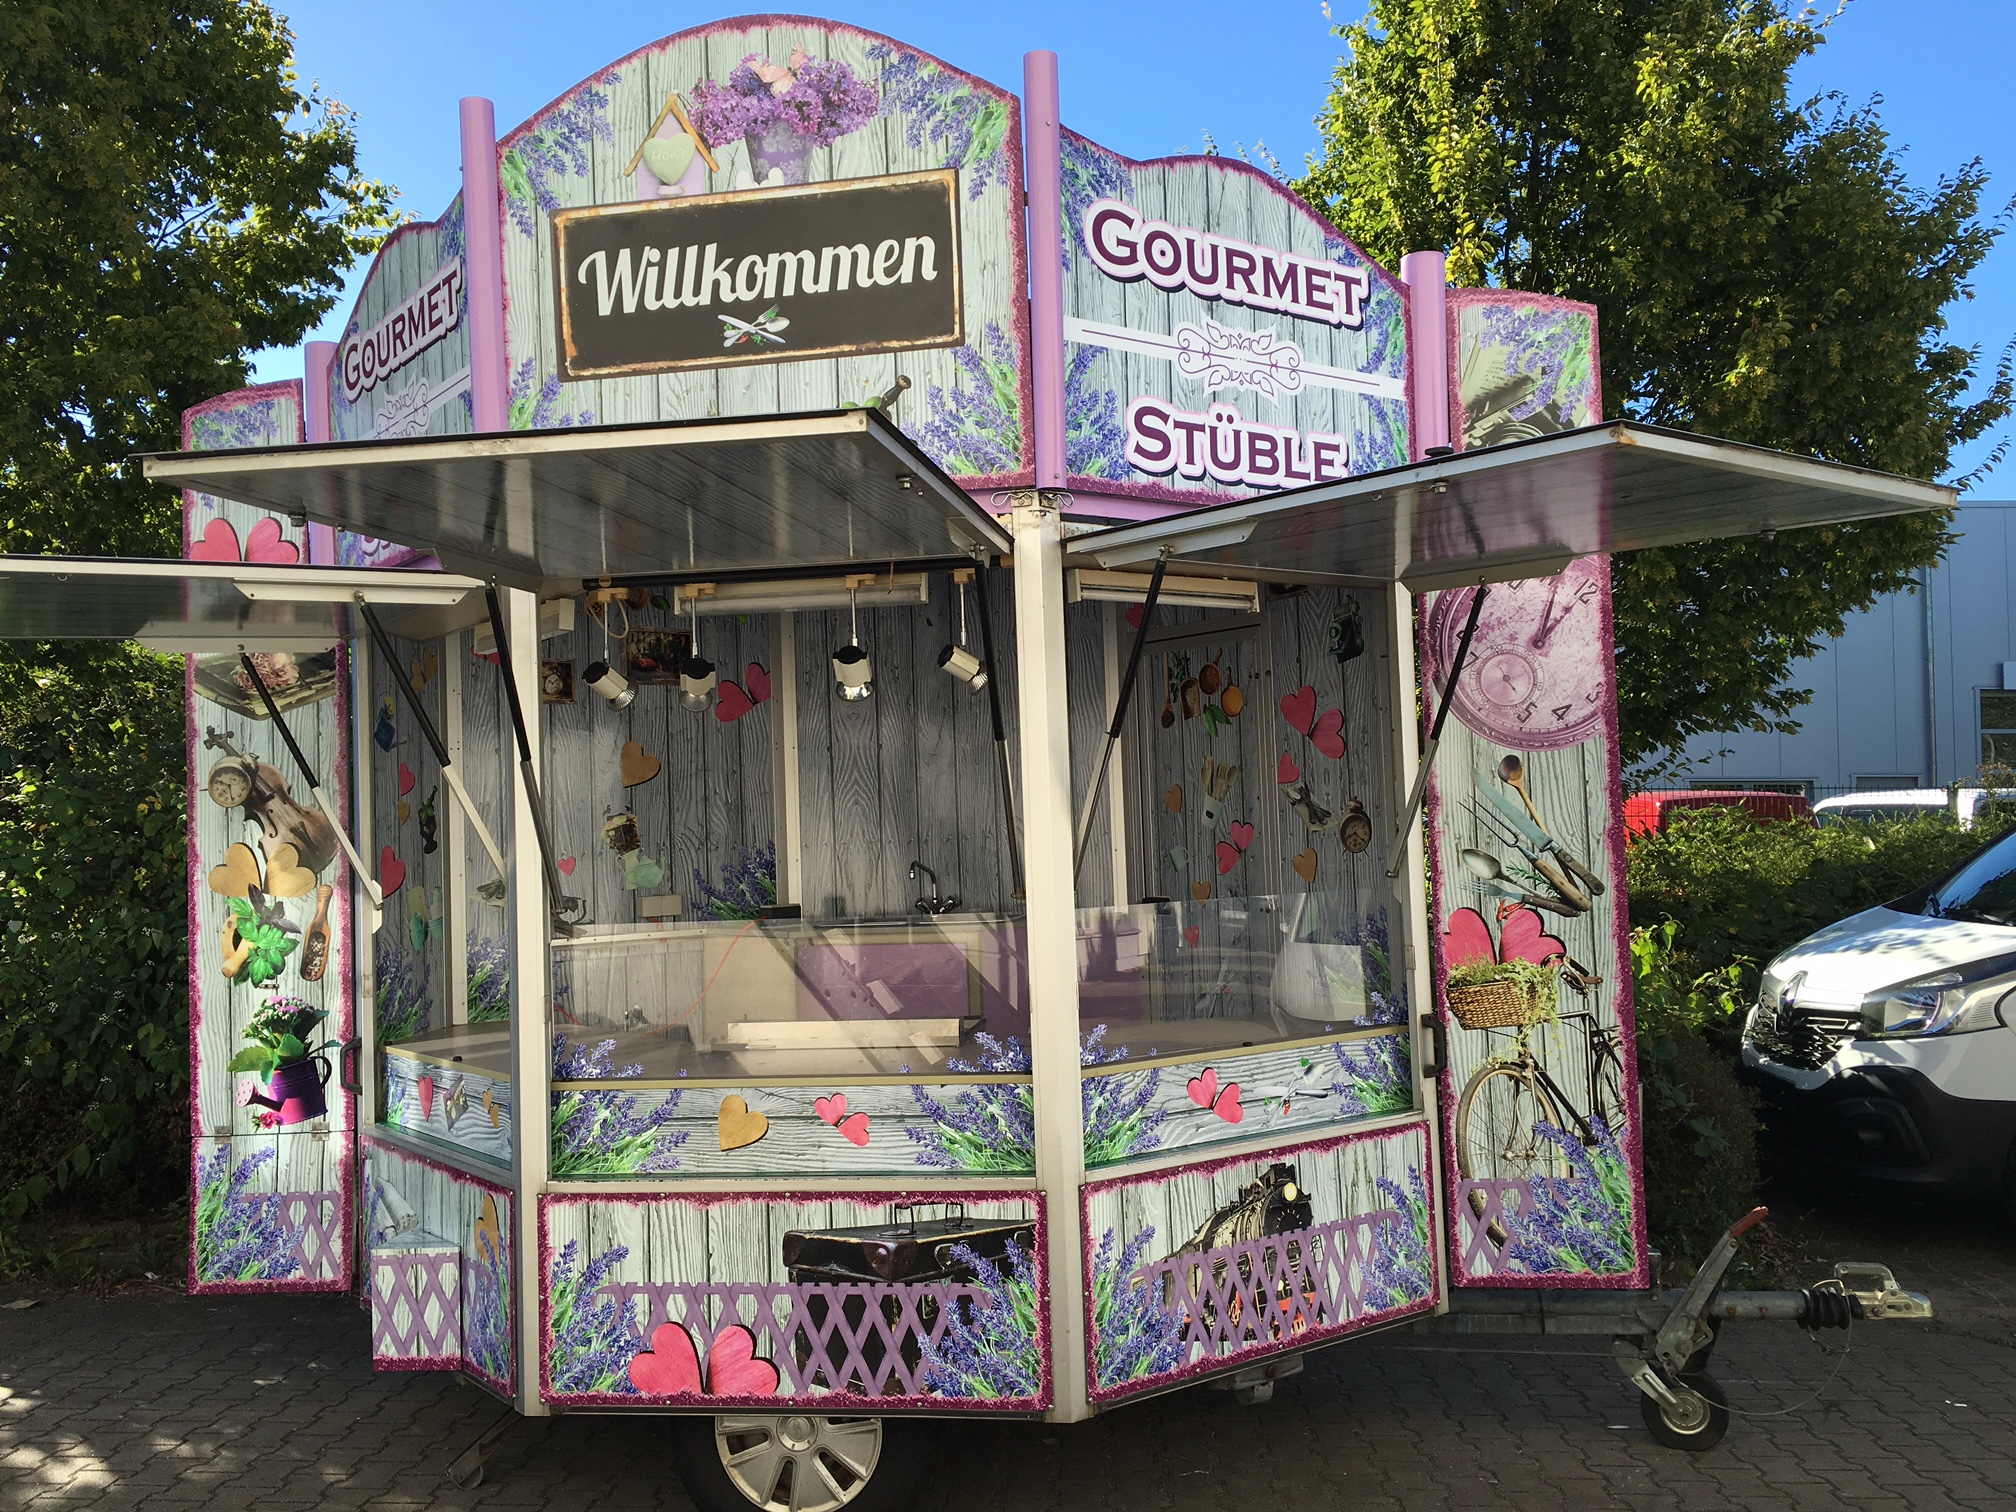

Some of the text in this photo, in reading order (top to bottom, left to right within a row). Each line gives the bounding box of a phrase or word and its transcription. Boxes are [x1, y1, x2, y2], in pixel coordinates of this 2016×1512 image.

[577, 234, 938, 316] Willkommen
[1091, 208, 1363, 317] GOURMET
[344, 268, 459, 392] GOURMET
[1132, 404, 1341, 483] STÜBLE
[1573, 577, 1600, 605] 12
[1516, 701, 1538, 724] 5
[1551, 703, 1573, 722] 4
